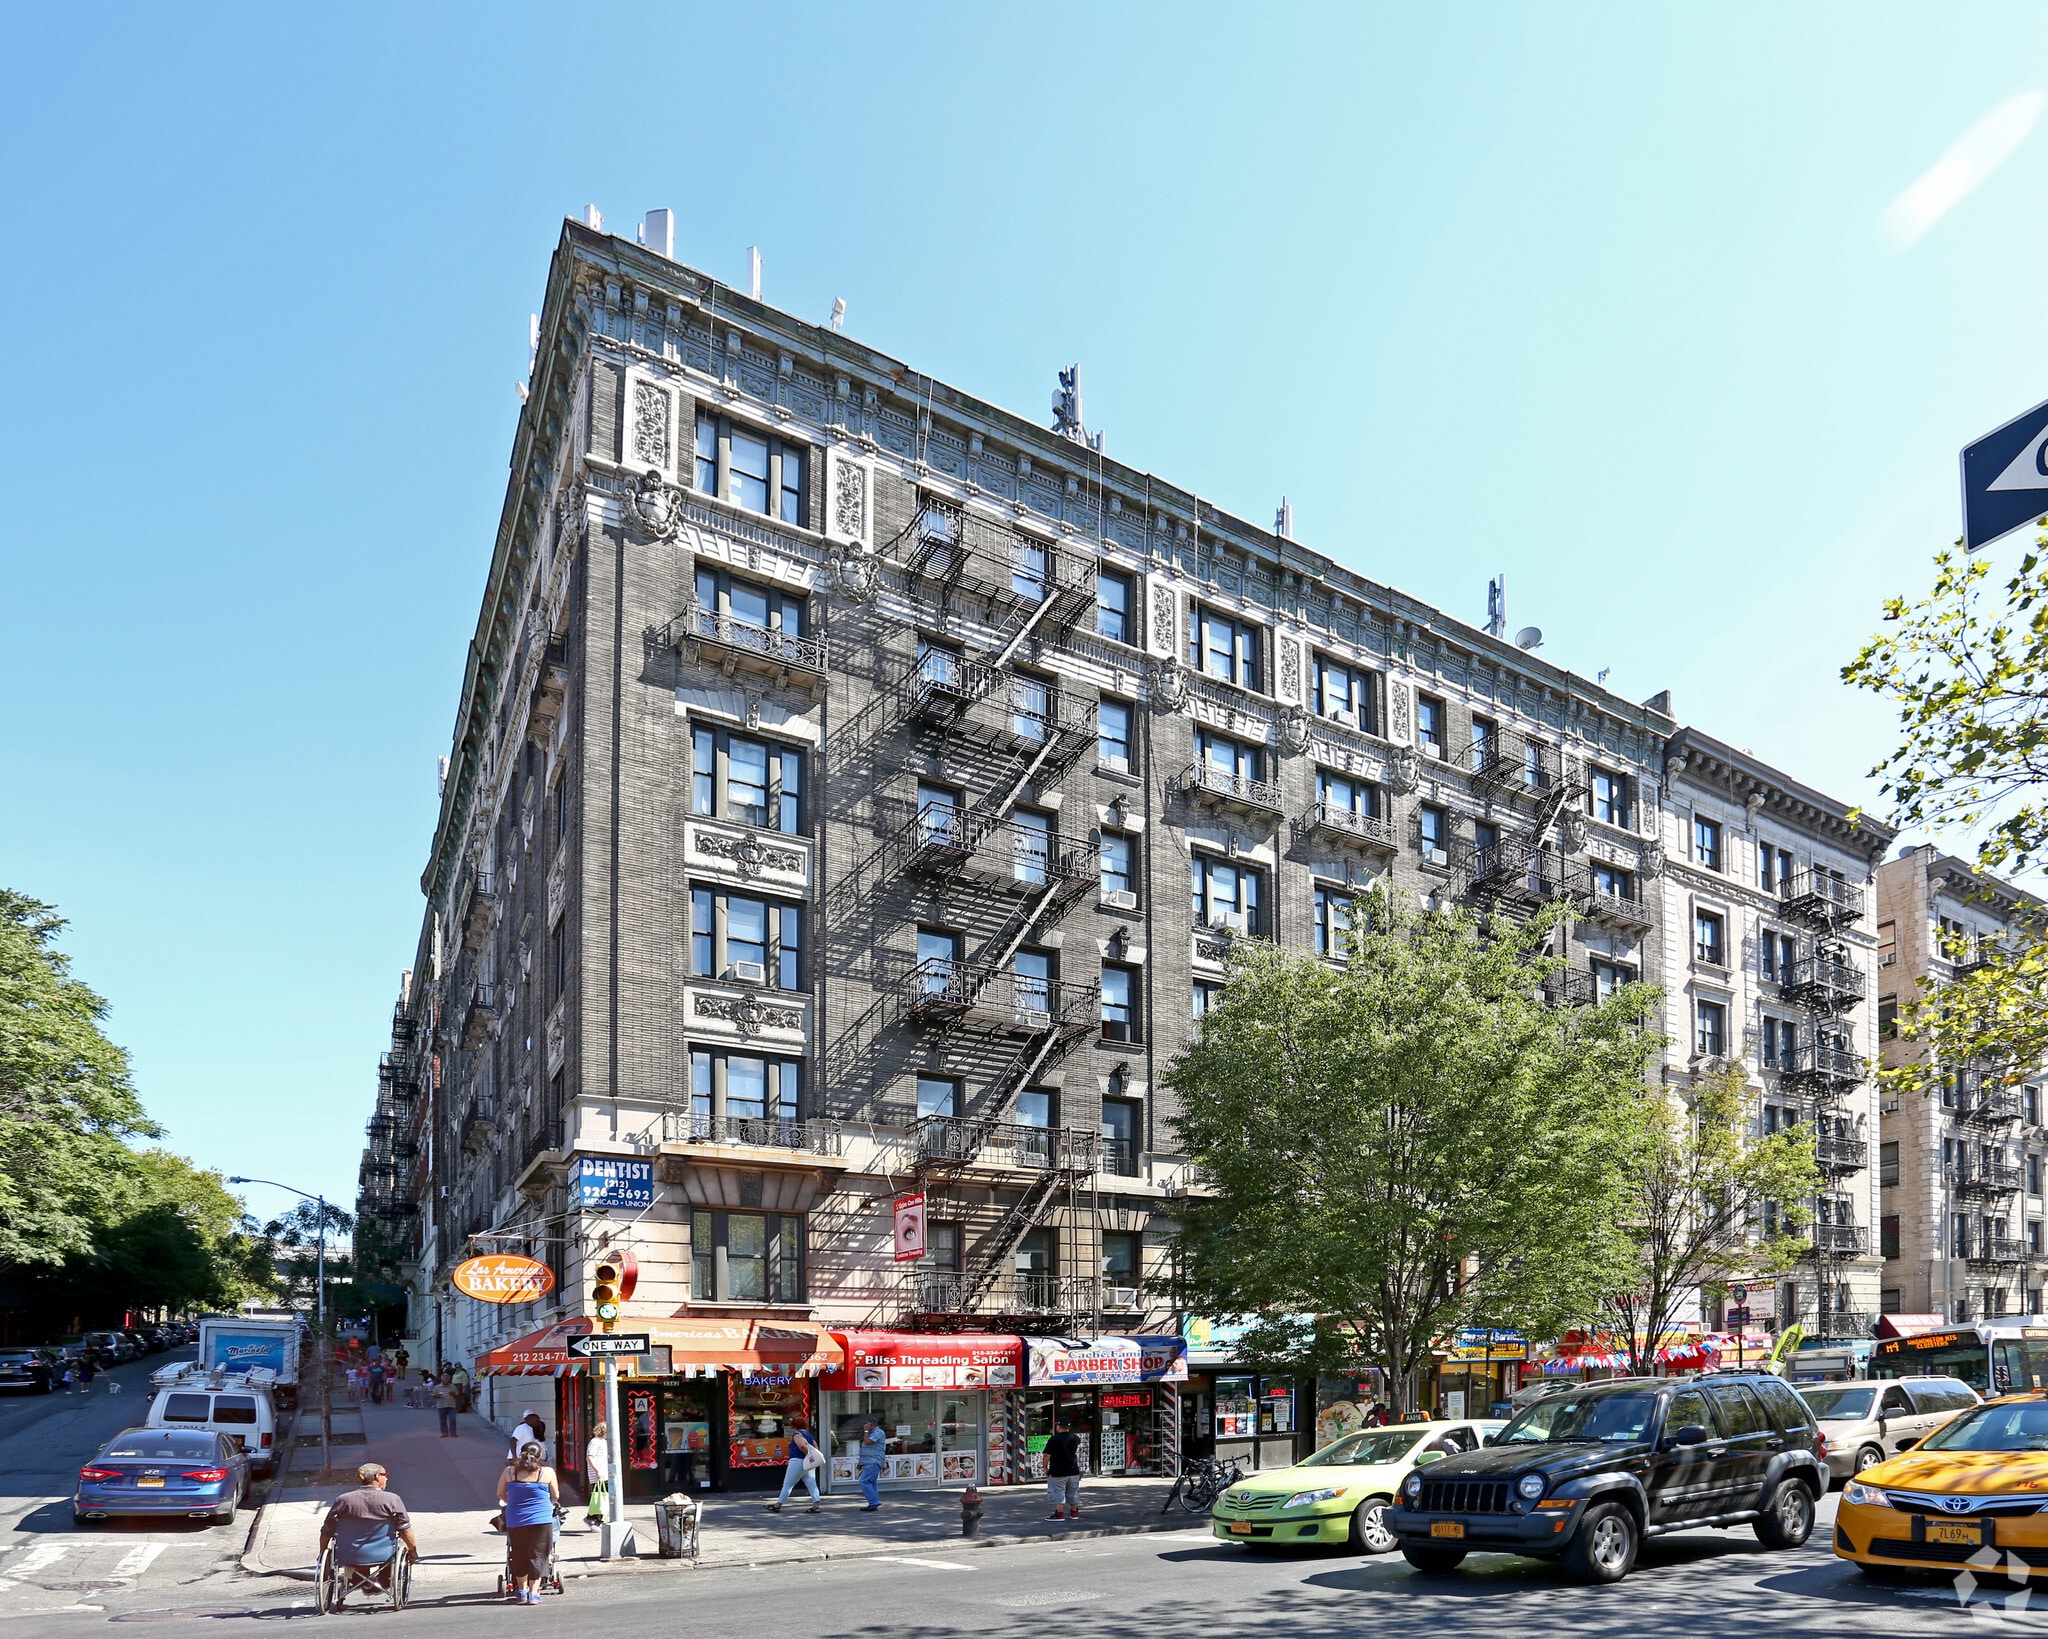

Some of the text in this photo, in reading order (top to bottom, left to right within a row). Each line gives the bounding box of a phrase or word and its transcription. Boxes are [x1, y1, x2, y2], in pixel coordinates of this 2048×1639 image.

[582, 1159, 650, 1180] DENTIST
[604, 1178, 629, 1189] (212)
[583, 1186, 650, 1200] 926-5692
[584, 1198, 619, 1206] MEDICAID
[466, 1260, 545, 1275] Las Americas
[468, 1277, 547, 1292] BAKERY
[648, 1327, 723, 1340] Americas
[721, 1328, 820, 1340] BAKERY
[582, 1340, 639, 1351] ONE WAY
[1886, 1342, 1900, 1353] M4
[512, 1353, 530, 1362] 212
[801, 1353, 828, 1361] 3362
[865, 1355, 1009, 1366] Bliss Threading Salon
[1054, 1356, 1163, 1373] BARBER SHOP
[743, 1376, 793, 1386] BAKERY
[637, 1399, 646, 1409] A
